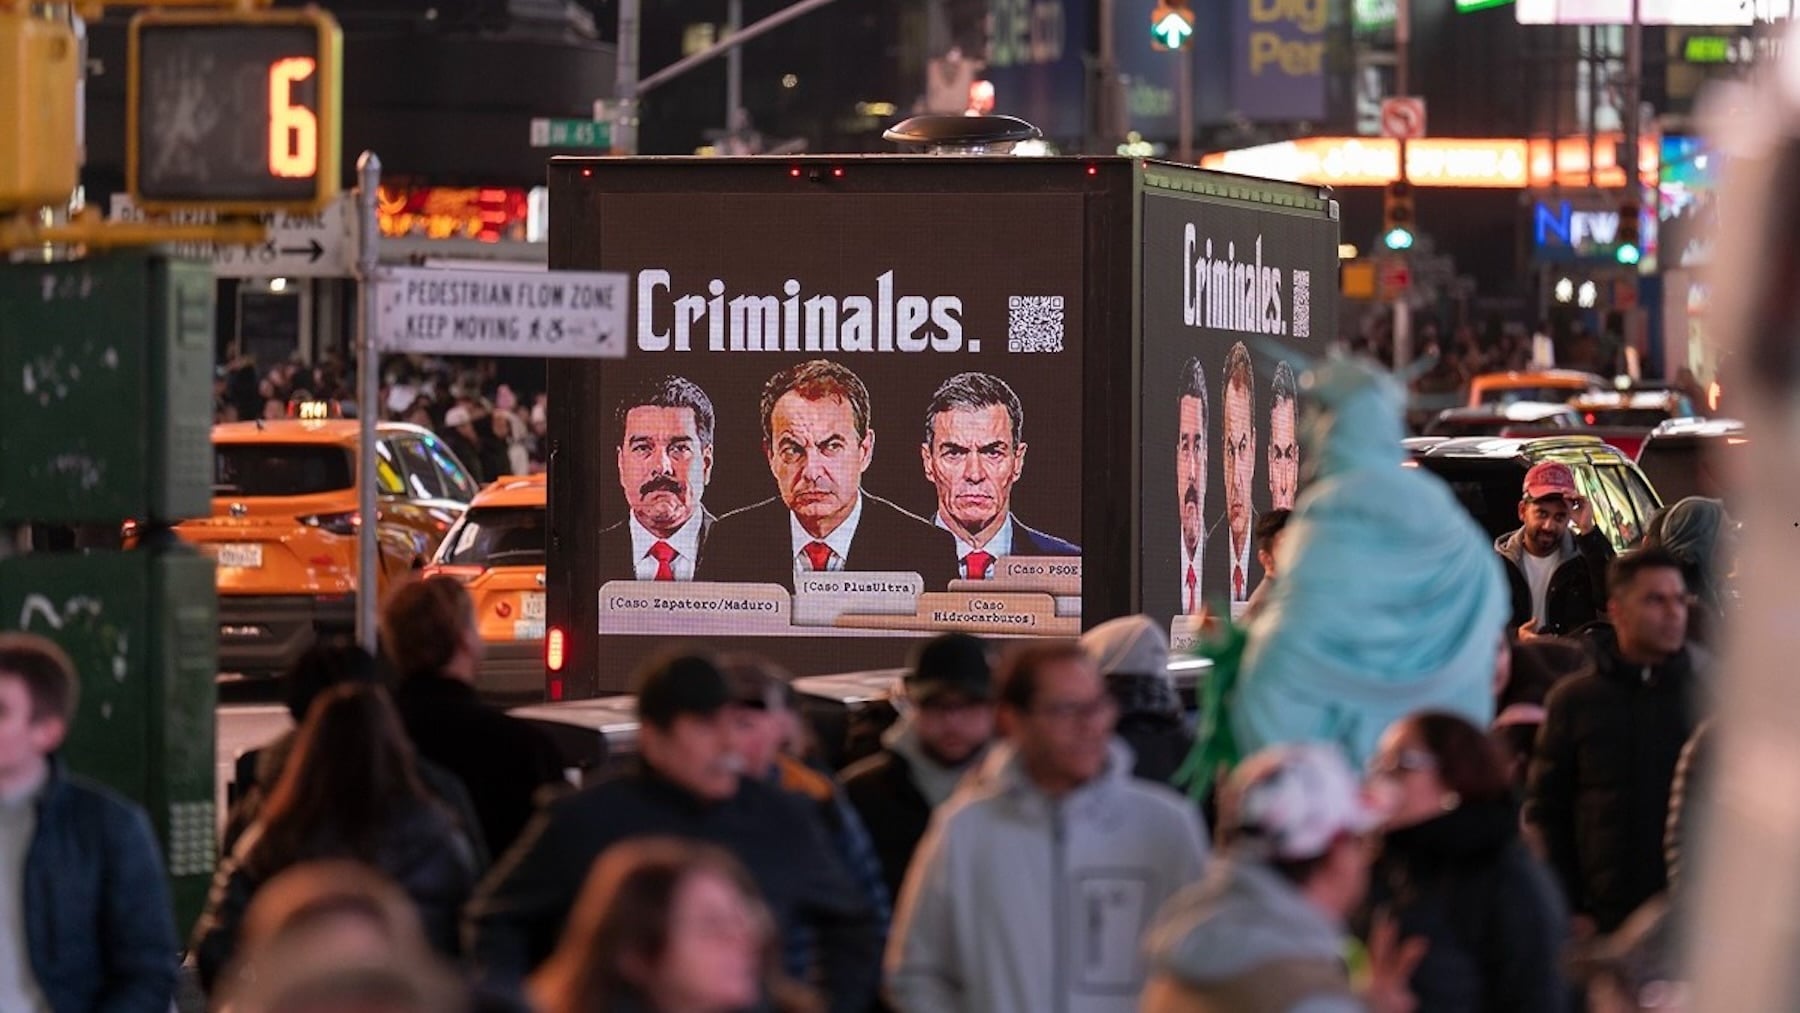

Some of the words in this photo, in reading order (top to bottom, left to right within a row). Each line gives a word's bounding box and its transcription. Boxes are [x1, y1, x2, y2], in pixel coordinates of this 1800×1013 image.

[269, 56, 317, 178] 6
[1184, 222, 1287, 335] Criminales.
[407, 279, 512, 307] PEDESTRIAN
[518, 282, 564, 308] FLOW
[570, 284, 615, 310] ZONE
[637, 269, 980, 352] Criminales.
[407, 313, 448, 340] KEEP
[454, 315, 519, 342] MOVING
[1008, 563, 1044, 576] [Caso
[803, 581, 839, 593] [Caso
[844, 582, 916, 595] PlusUltra]
[609, 597, 648, 610] [Caso
[653, 598, 780, 613] Zapatero/Maduro]
[968, 600, 1004, 611] [Caso
[934, 612, 1036, 626] Hidrocarburos]
